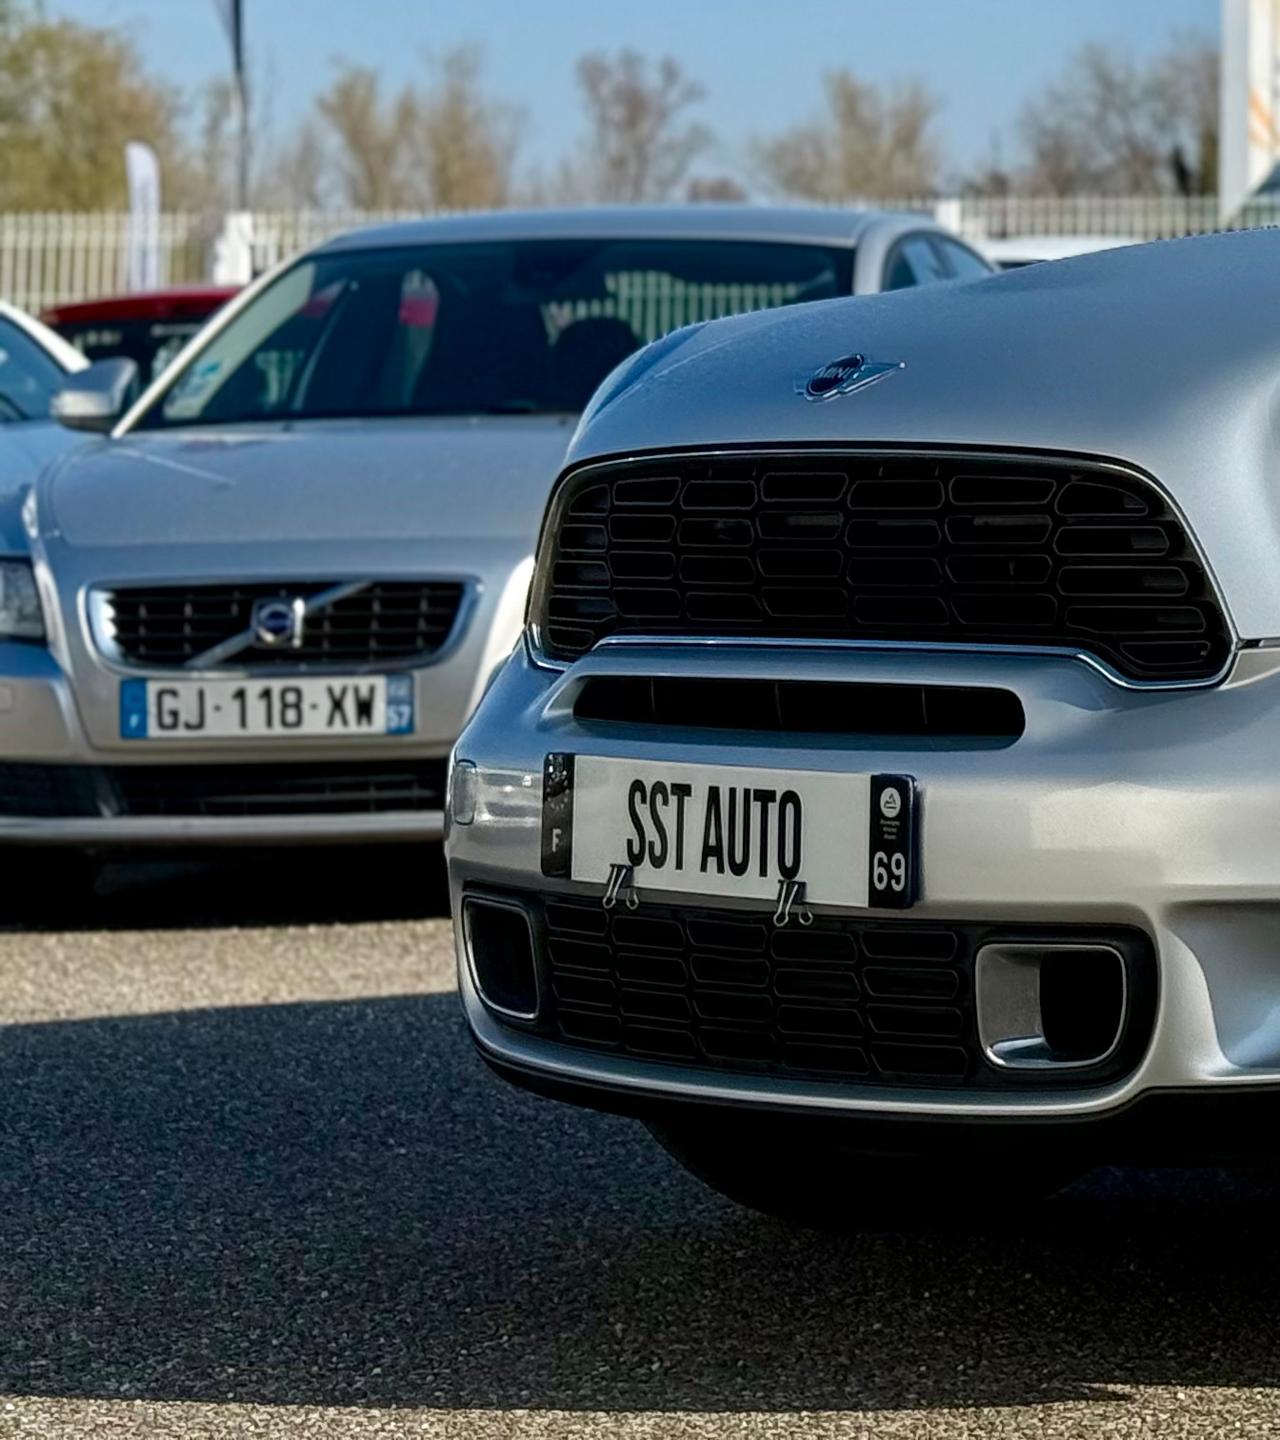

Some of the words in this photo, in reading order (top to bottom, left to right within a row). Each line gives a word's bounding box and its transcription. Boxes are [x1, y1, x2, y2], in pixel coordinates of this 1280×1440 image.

[551, 827, 563, 853] F
[627, 779, 692, 871] SST
[700, 785, 803, 880] AUTO
[873, 851, 906, 892] 69
